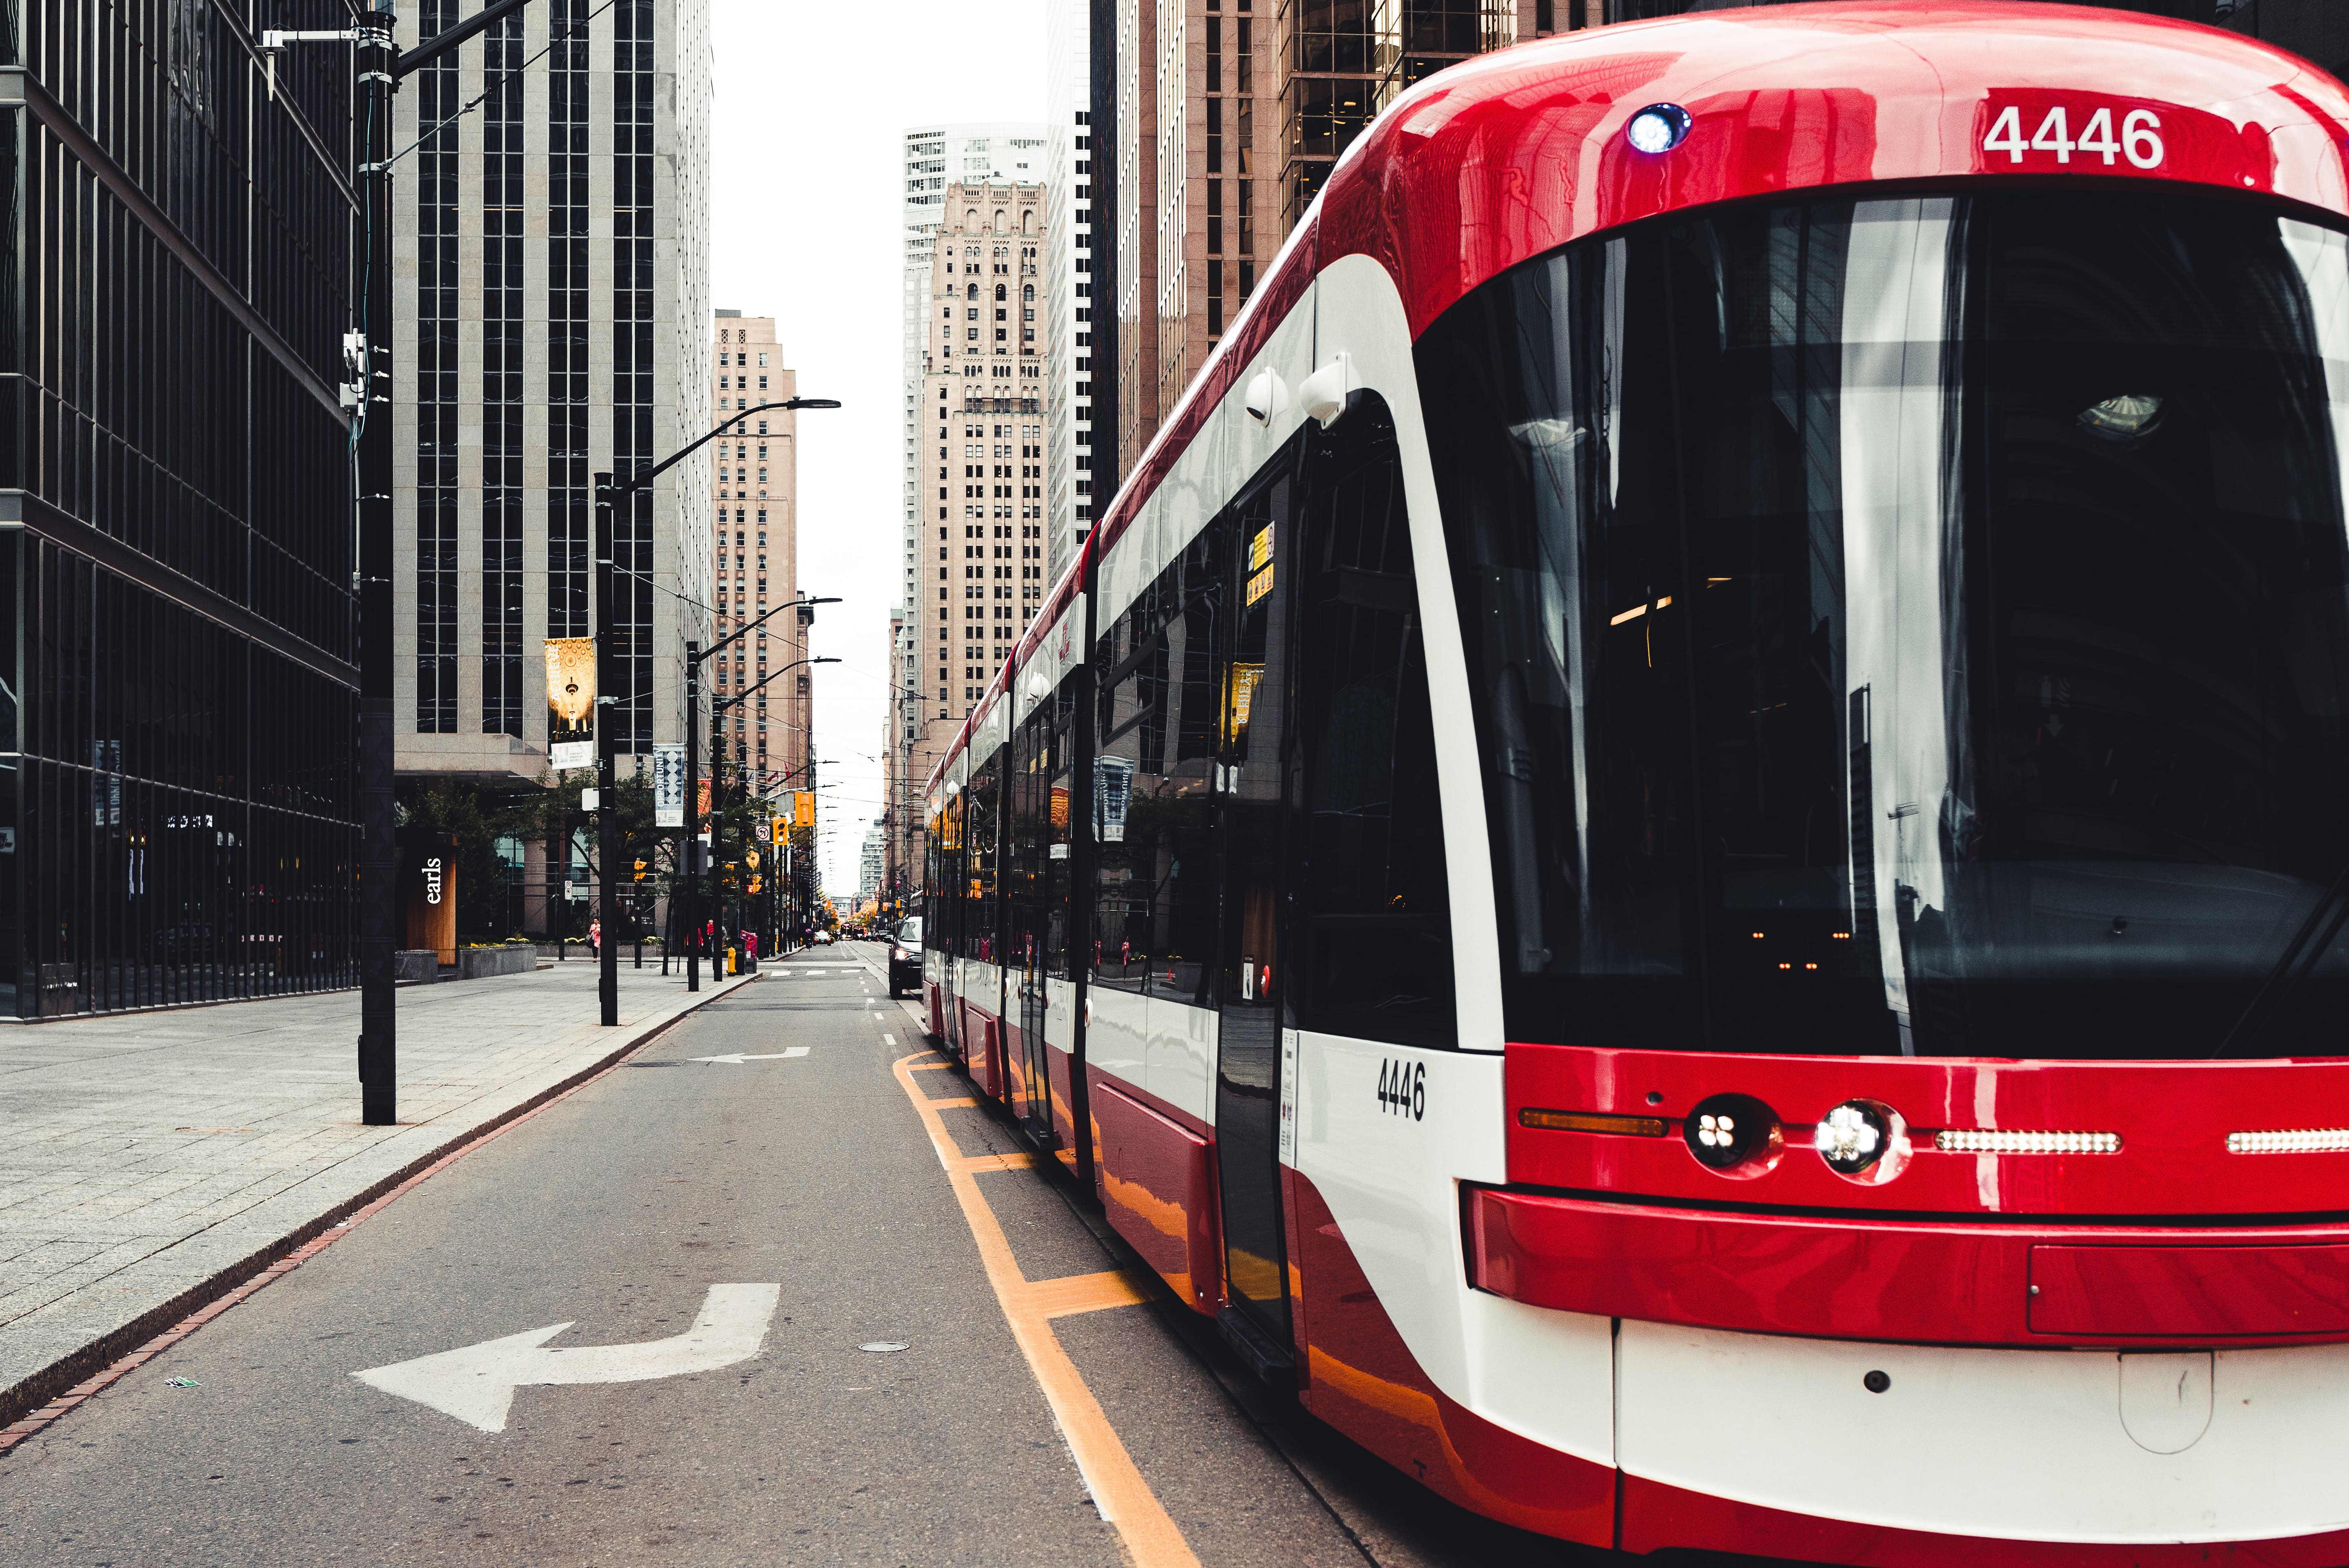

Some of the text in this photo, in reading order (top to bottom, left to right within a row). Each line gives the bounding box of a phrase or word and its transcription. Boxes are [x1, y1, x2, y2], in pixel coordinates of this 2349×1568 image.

[1983, 106, 2164, 169] 4446
[548, 645, 561, 701] ACHIEVE
[656, 747, 664, 807] OPPORTUNITY
[422, 858, 441, 904] earls
[1378, 1058, 1425, 1122] 4446
